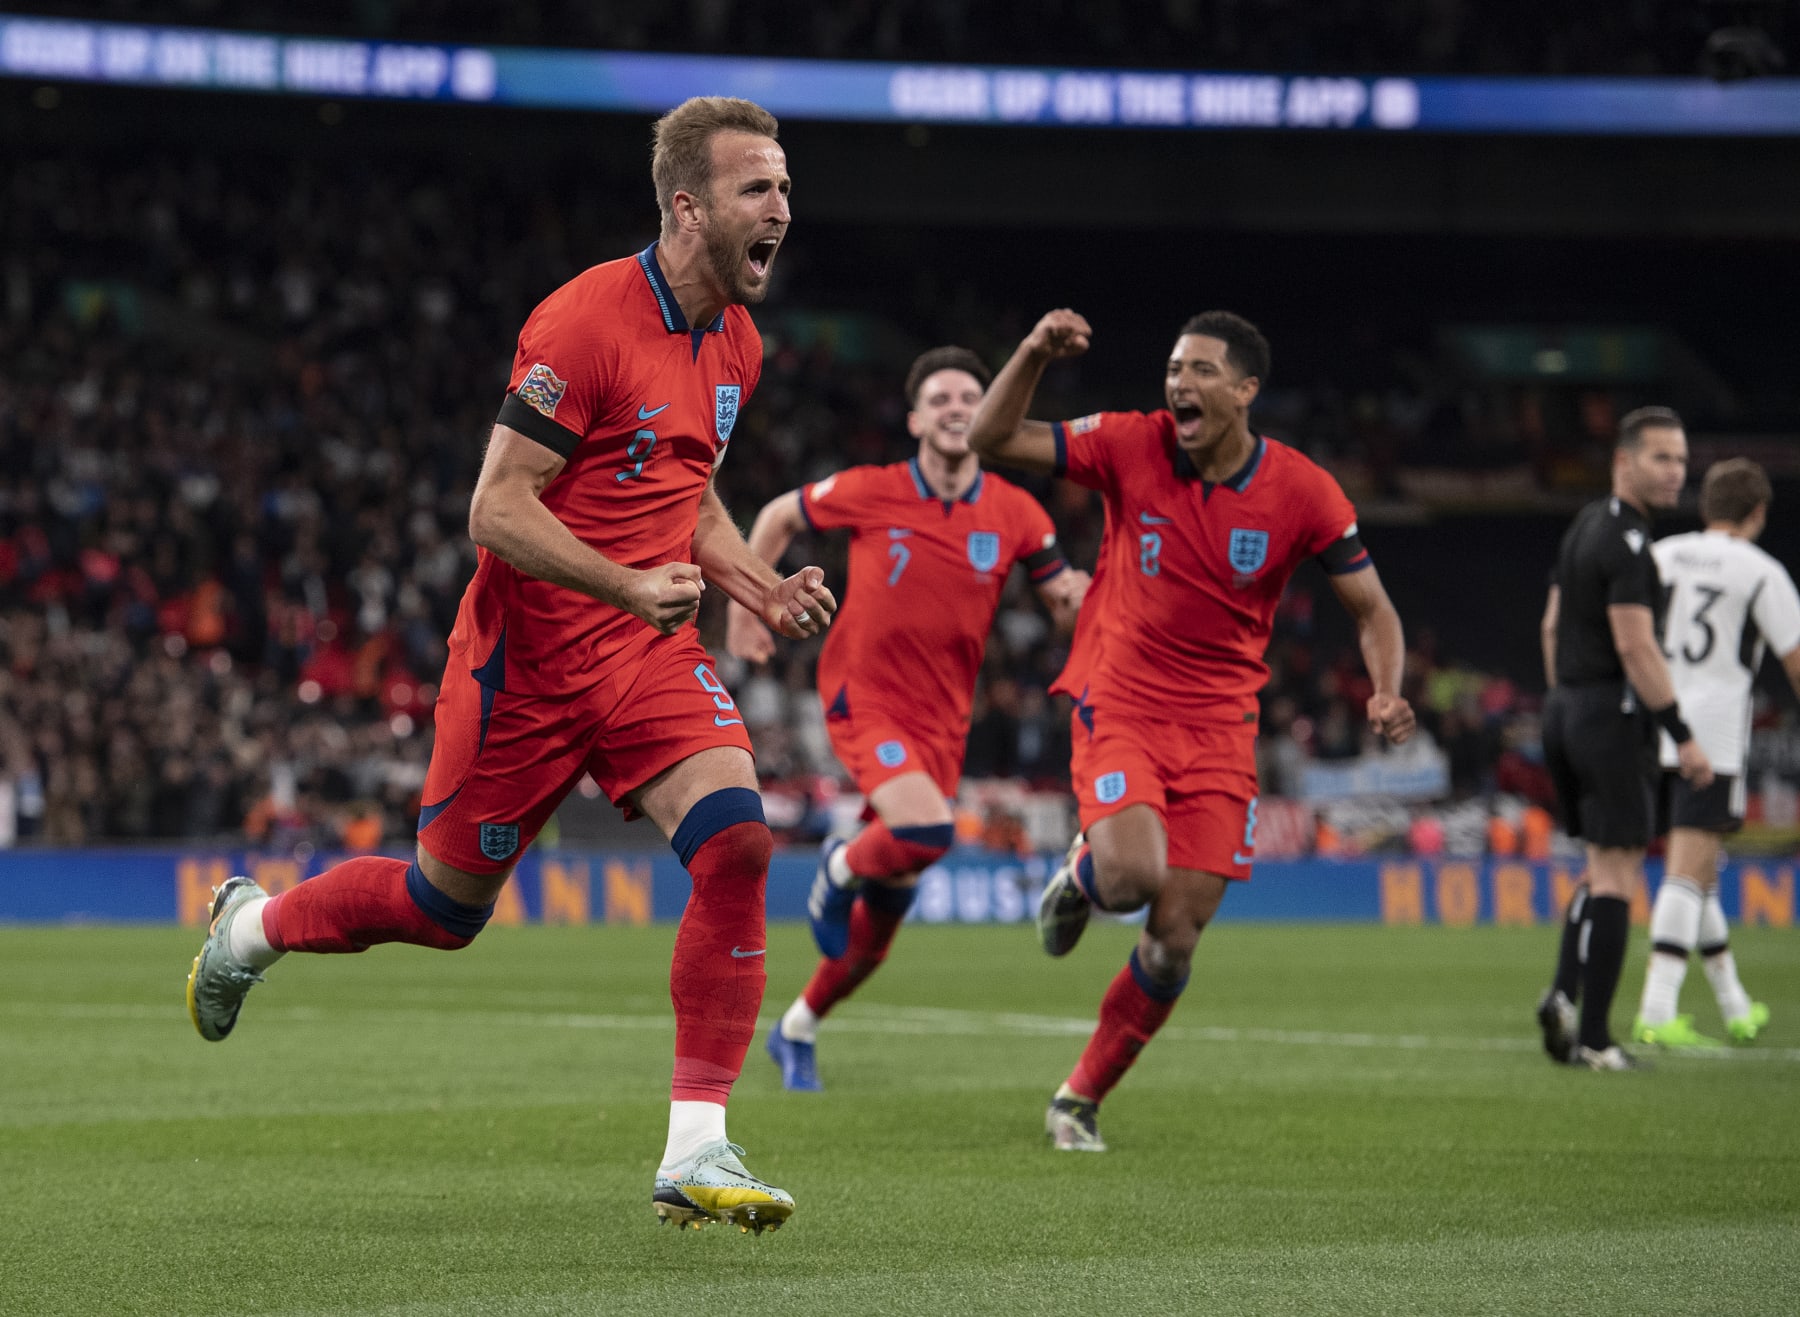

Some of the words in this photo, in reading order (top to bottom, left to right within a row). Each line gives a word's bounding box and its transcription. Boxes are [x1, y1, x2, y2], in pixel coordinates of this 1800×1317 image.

[615, 429, 657, 483] 9
[889, 542, 911, 587] 7
[1140, 532, 1162, 577] 8
[693, 662, 734, 711] 9
